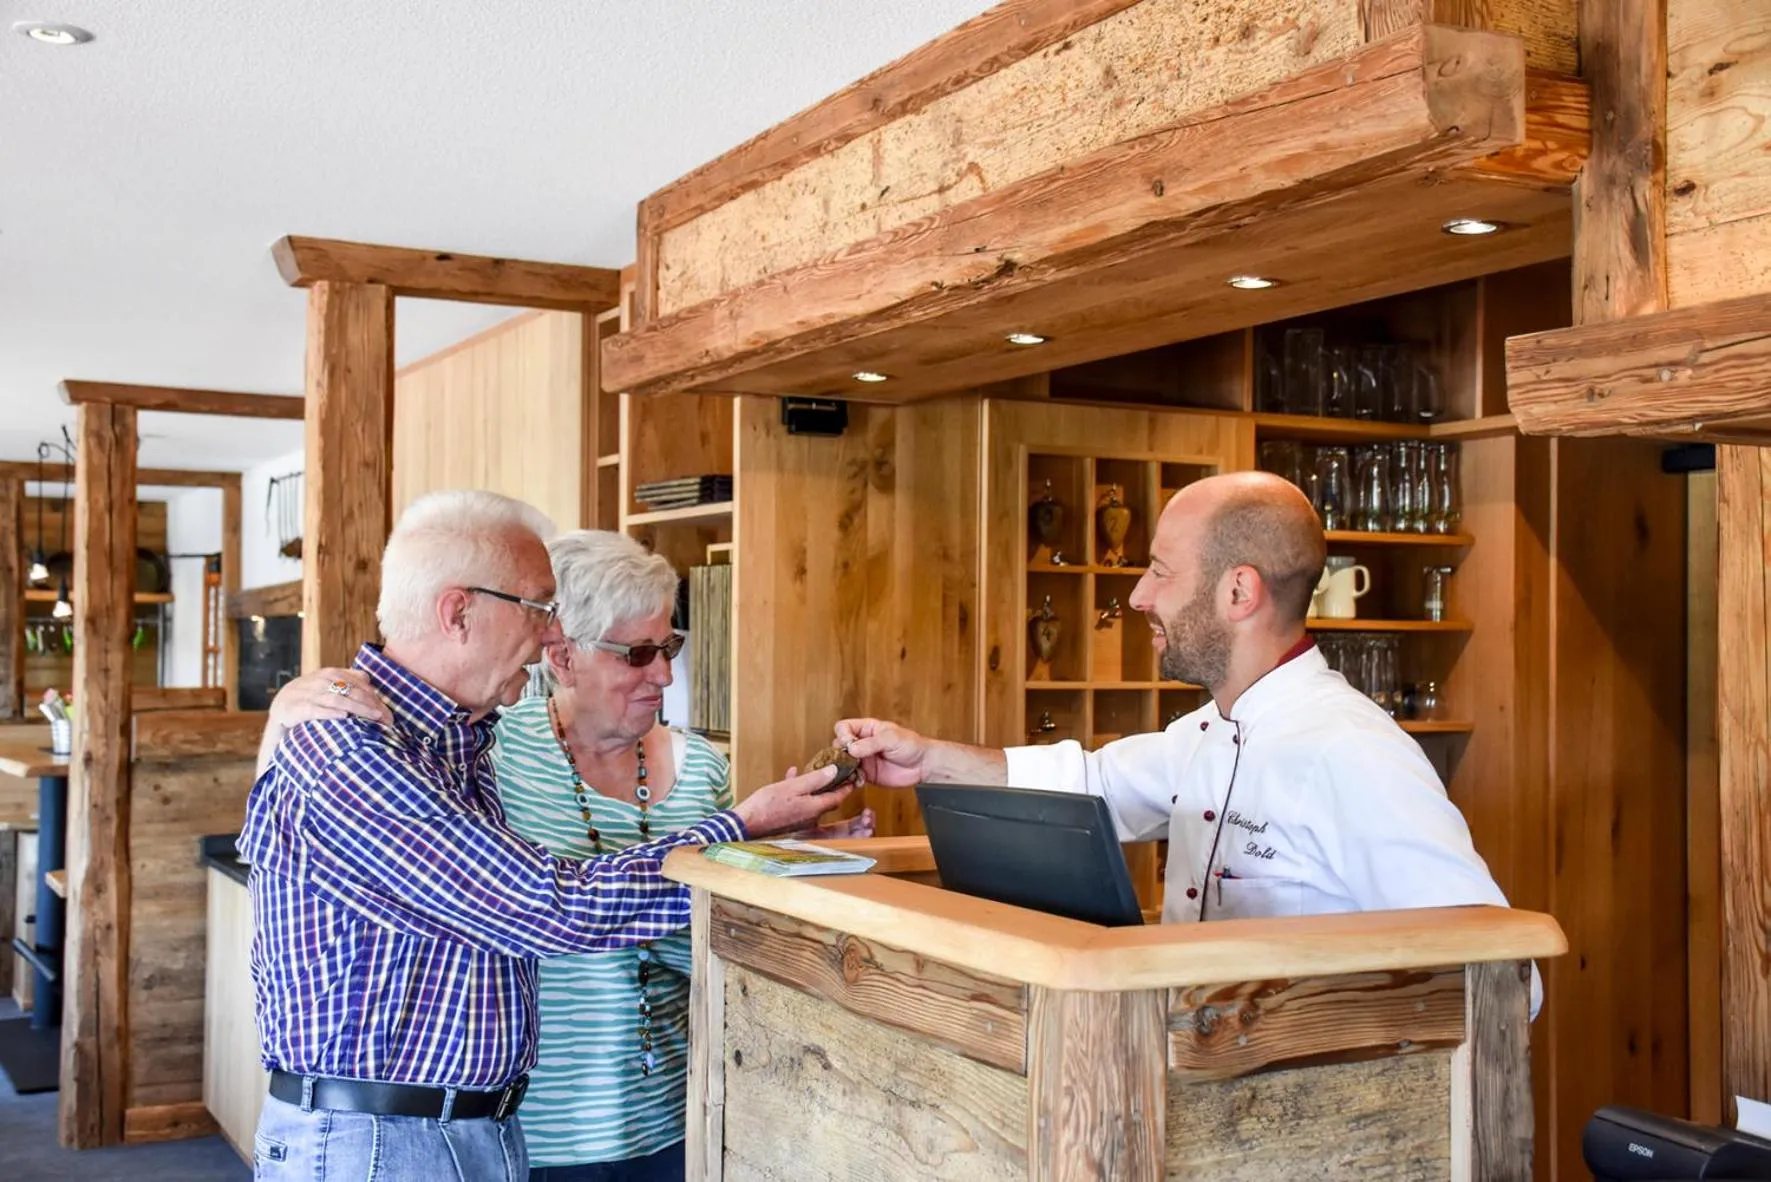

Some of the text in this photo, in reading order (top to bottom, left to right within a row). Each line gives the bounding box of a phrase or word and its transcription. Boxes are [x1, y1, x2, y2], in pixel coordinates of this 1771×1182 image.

[1227, 810, 1269, 835] Christoph
[1244, 841, 1277, 859] Dold
[1628, 1142, 1654, 1158] EPSON
